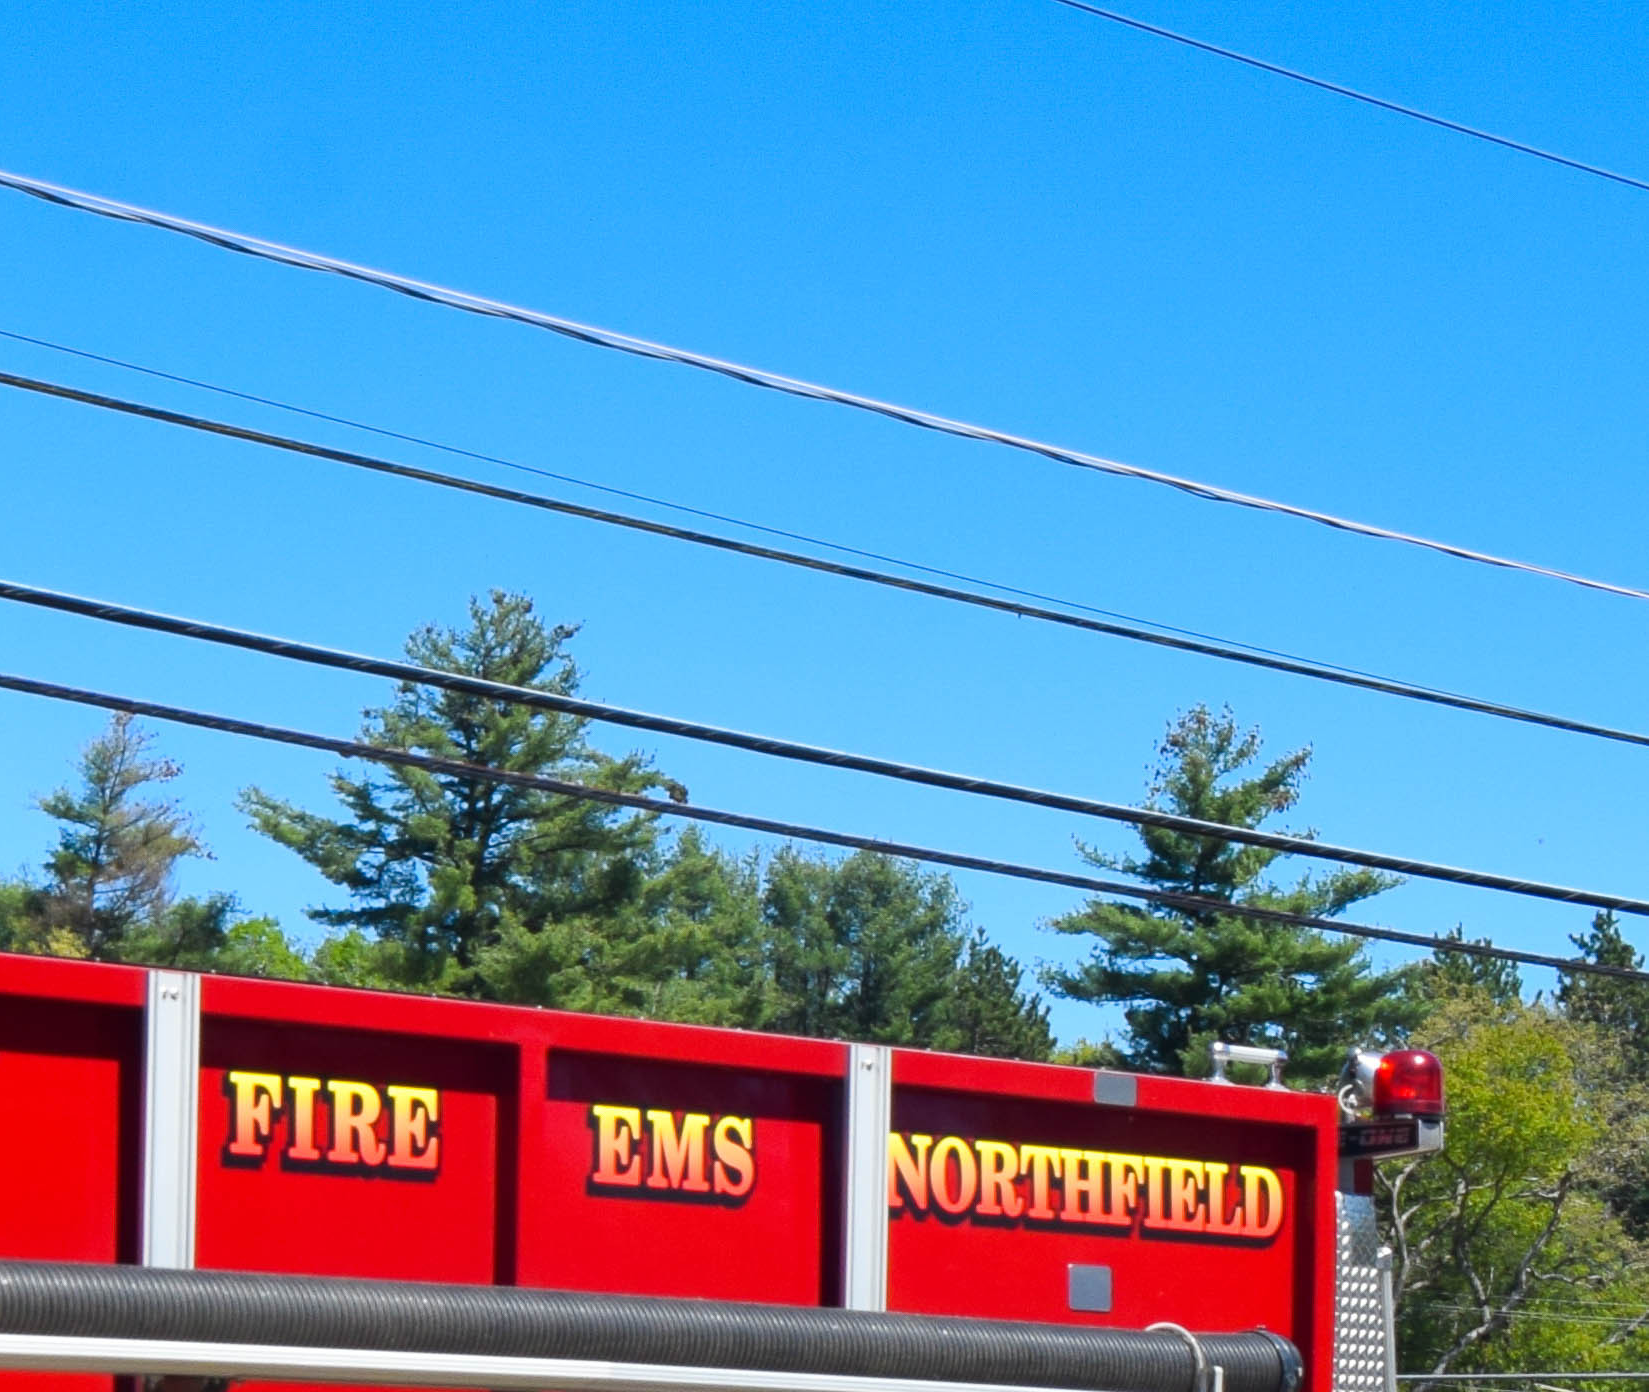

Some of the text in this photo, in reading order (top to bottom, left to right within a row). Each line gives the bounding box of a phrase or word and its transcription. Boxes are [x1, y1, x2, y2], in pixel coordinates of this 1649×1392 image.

[227, 1070, 440, 1173] FIRE
[590, 1104, 757, 1200] EMS
[888, 1132, 1284, 1243] NORTHFIELD
